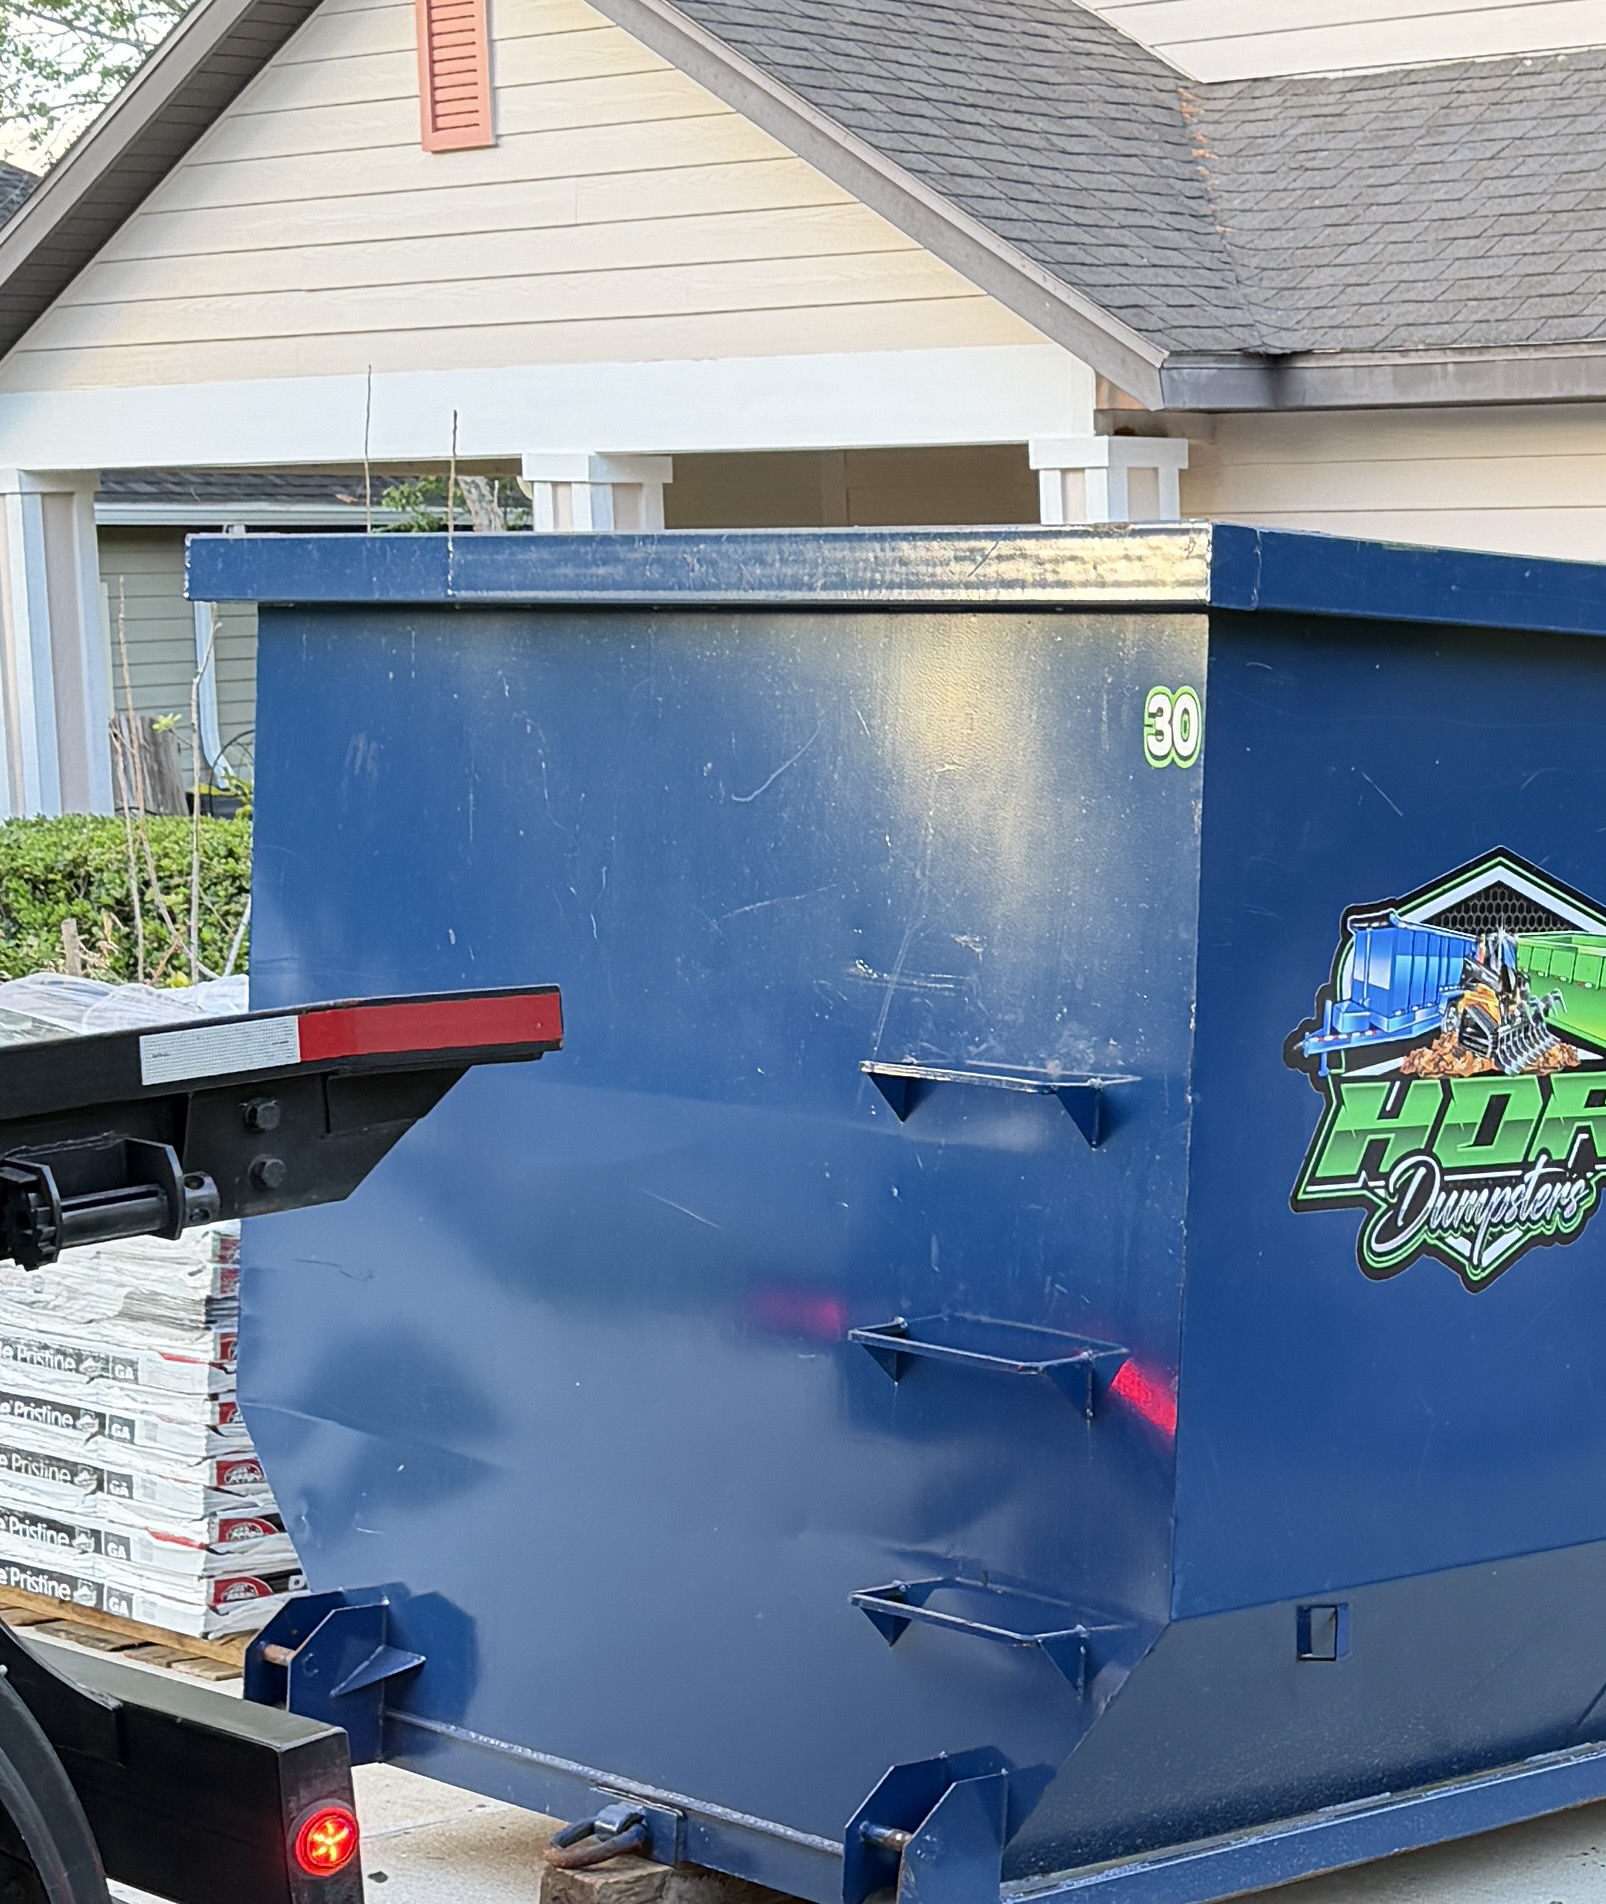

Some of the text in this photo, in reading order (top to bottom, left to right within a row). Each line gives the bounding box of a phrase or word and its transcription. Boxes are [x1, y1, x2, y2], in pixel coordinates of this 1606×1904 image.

[1144, 686, 1201, 768] 30
[1370, 1153, 1590, 1266] Dumpsters
[17, 1344, 76, 1370] Pristine
[14, 1401, 74, 1429] Pristine
[11, 1453, 72, 1483] Pristine
[9, 1515, 70, 1546] Pristine
[107, 1542, 127, 1559] GA
[10, 1567, 71, 1601] Pristine
